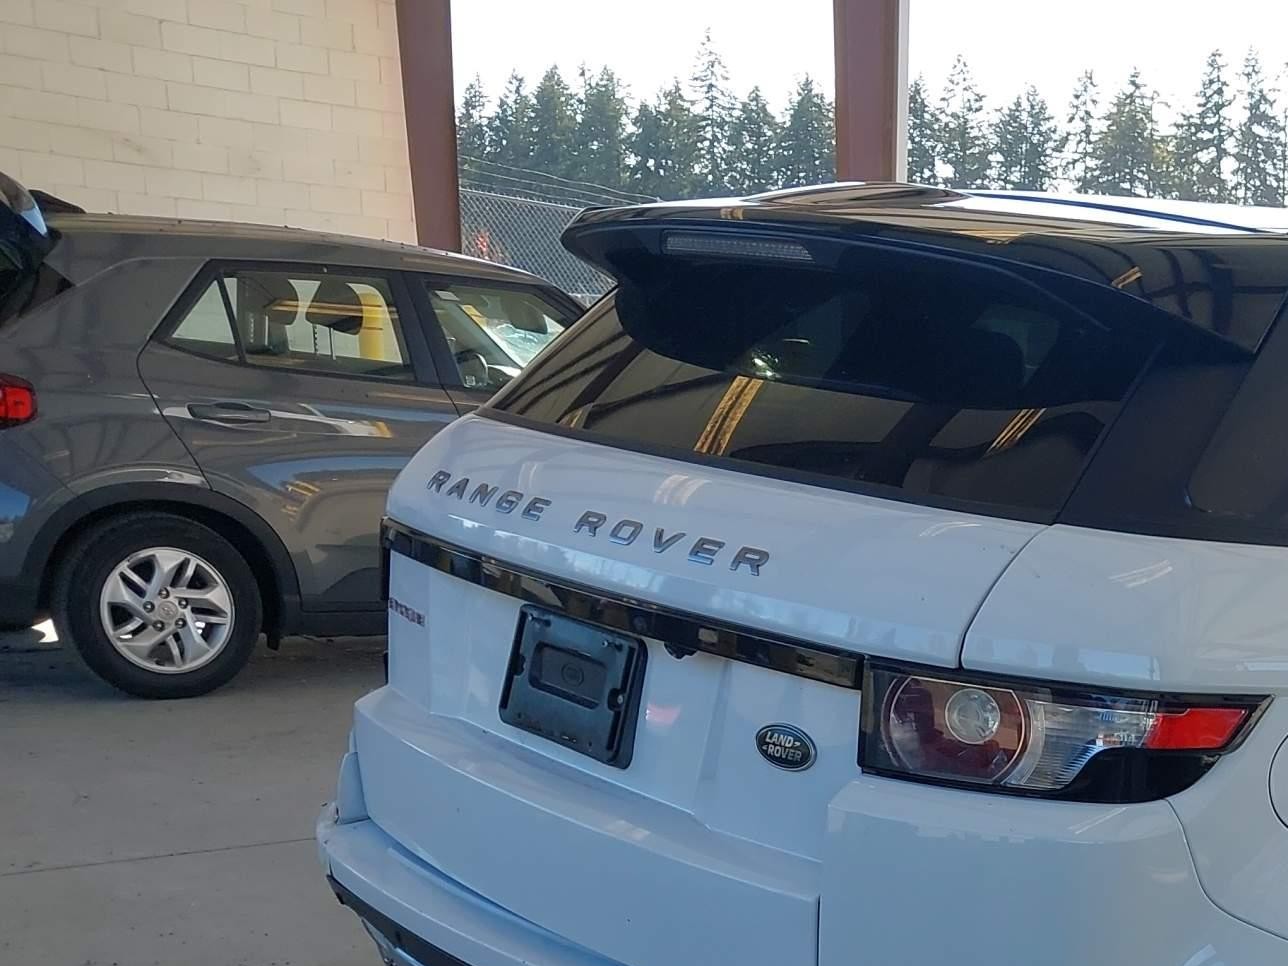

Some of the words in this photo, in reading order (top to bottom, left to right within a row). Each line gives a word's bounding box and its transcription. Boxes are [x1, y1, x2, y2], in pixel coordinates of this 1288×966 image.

[427, 470, 551, 522] RANGE
[573, 511, 770, 576] ROVER
[765, 731, 794, 747] LAND
[767, 744, 802, 761] ROVER
